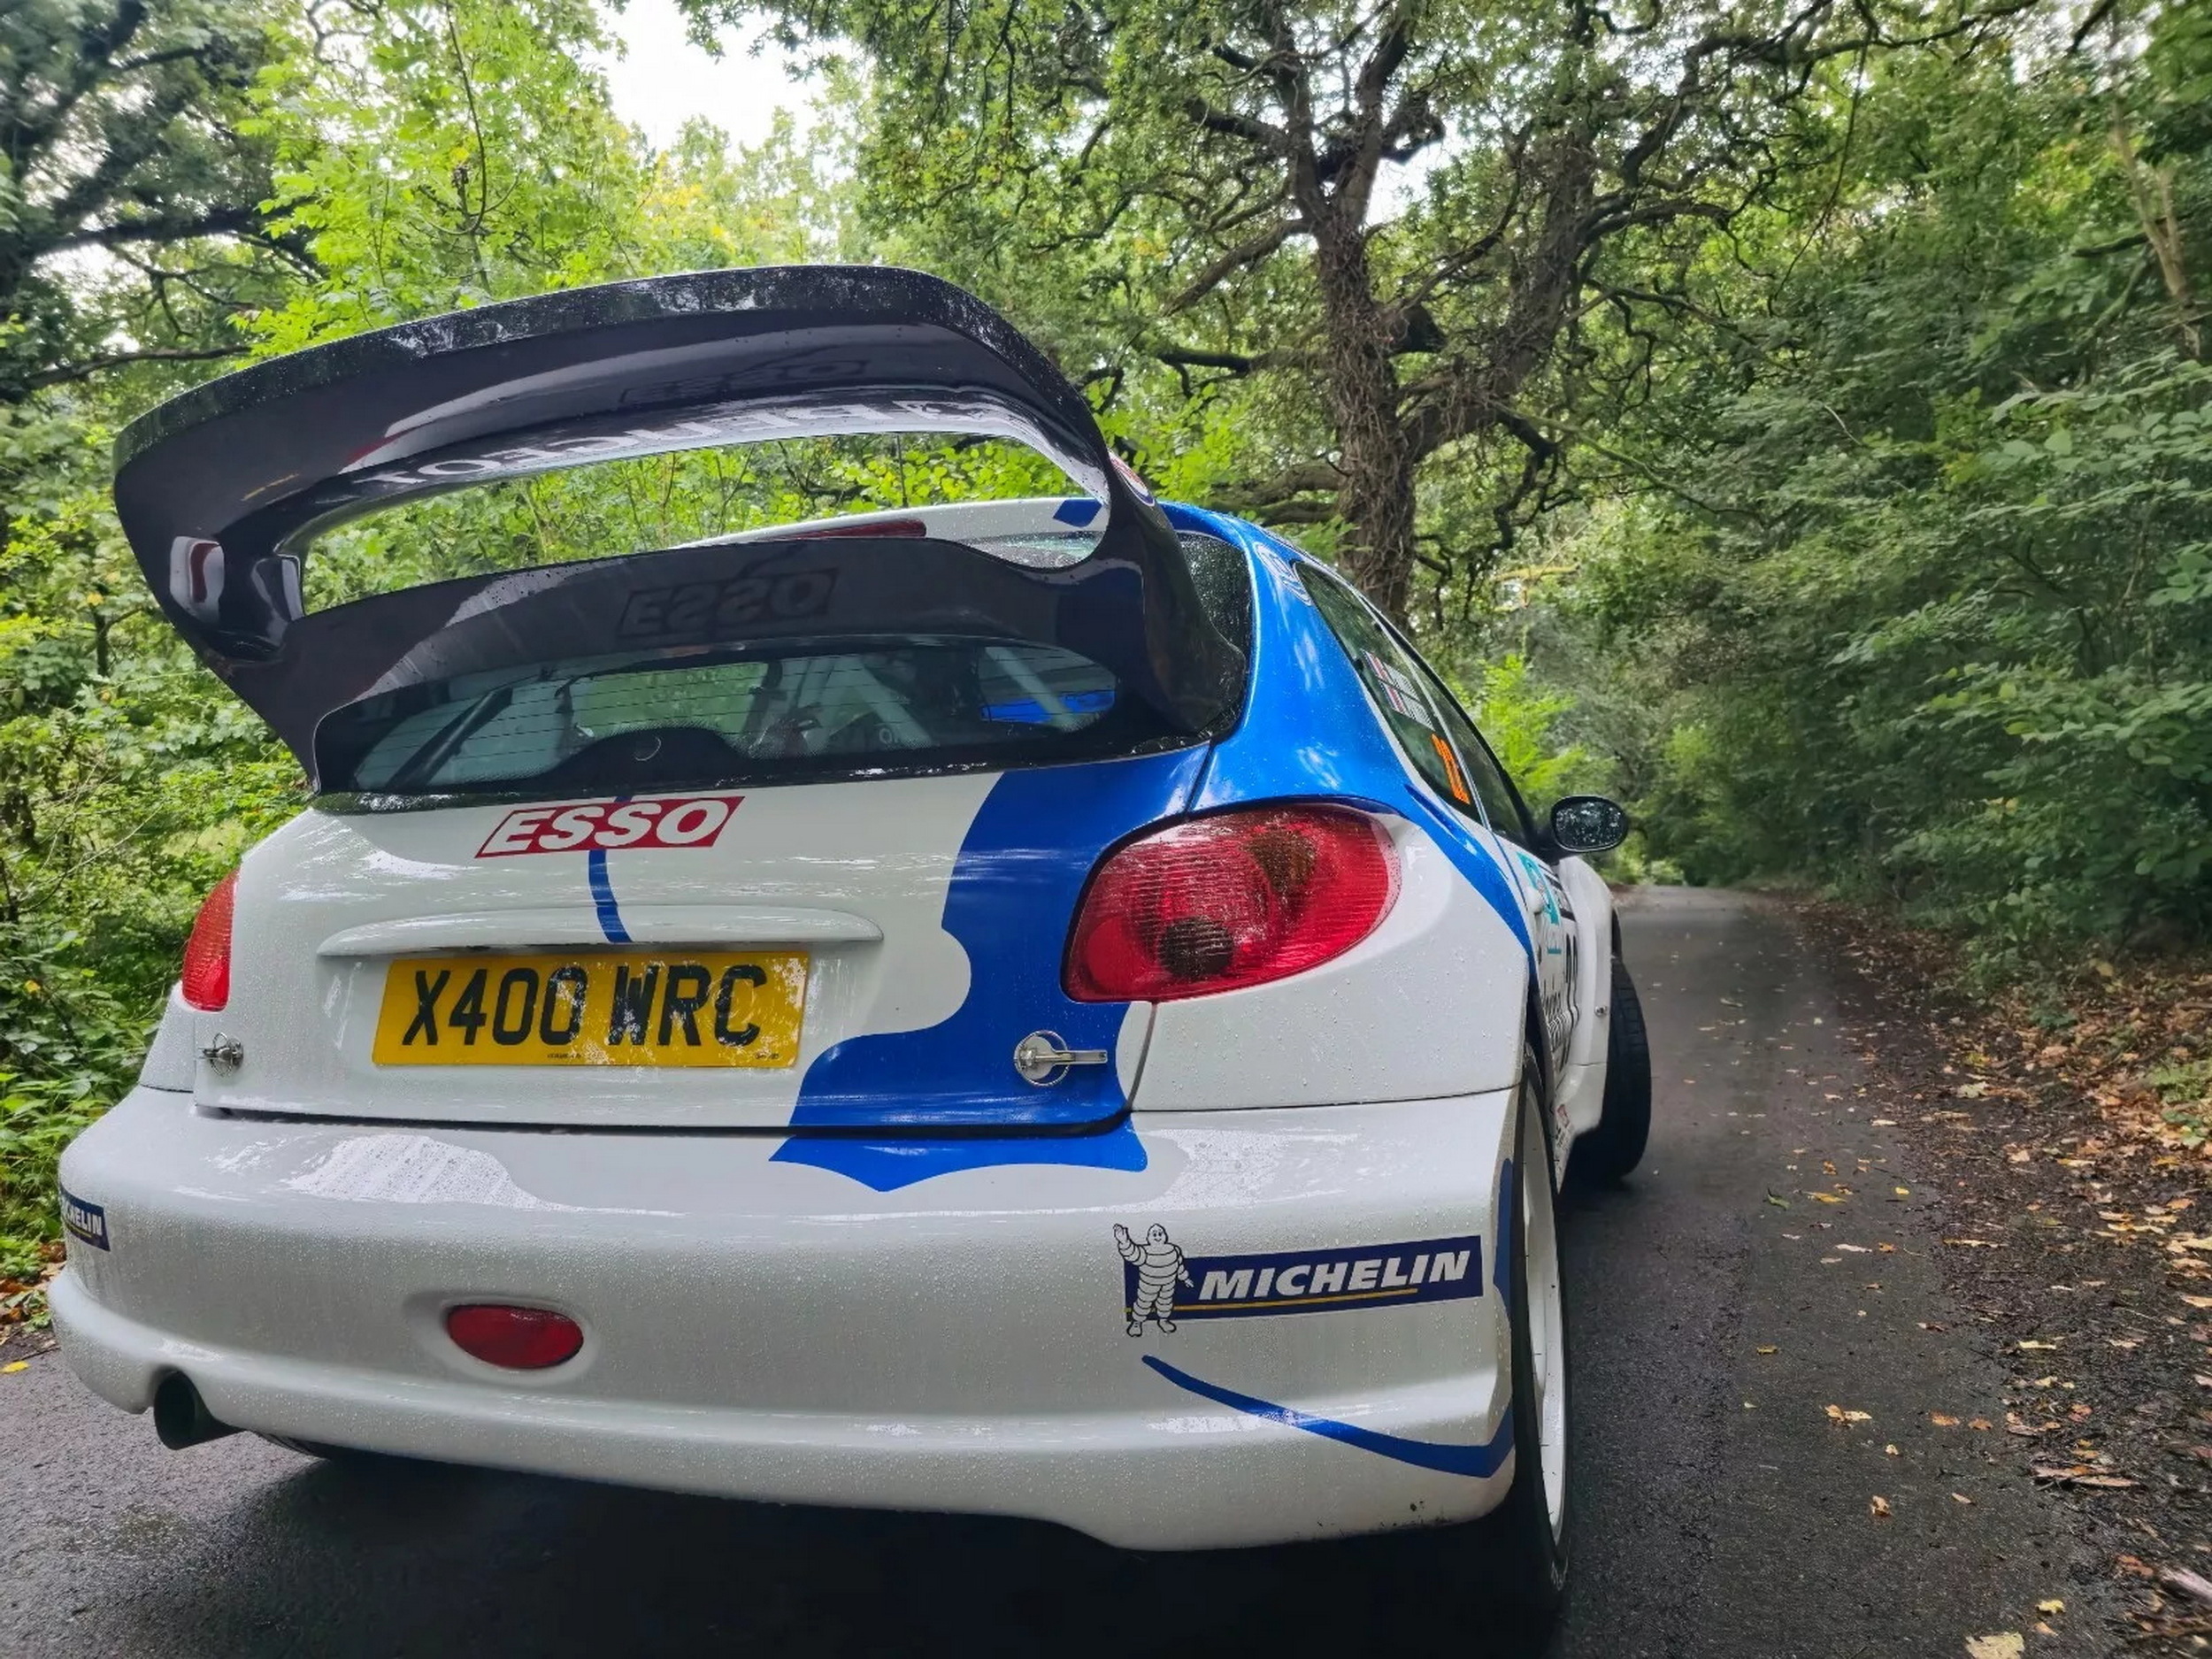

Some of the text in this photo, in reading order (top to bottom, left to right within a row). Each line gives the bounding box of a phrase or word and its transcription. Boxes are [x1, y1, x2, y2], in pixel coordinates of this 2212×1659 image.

[480, 800, 729, 855] ESSO
[402, 964, 768, 1047] X400 WRC
[1198, 1250, 1471, 1301] MICHELIN
